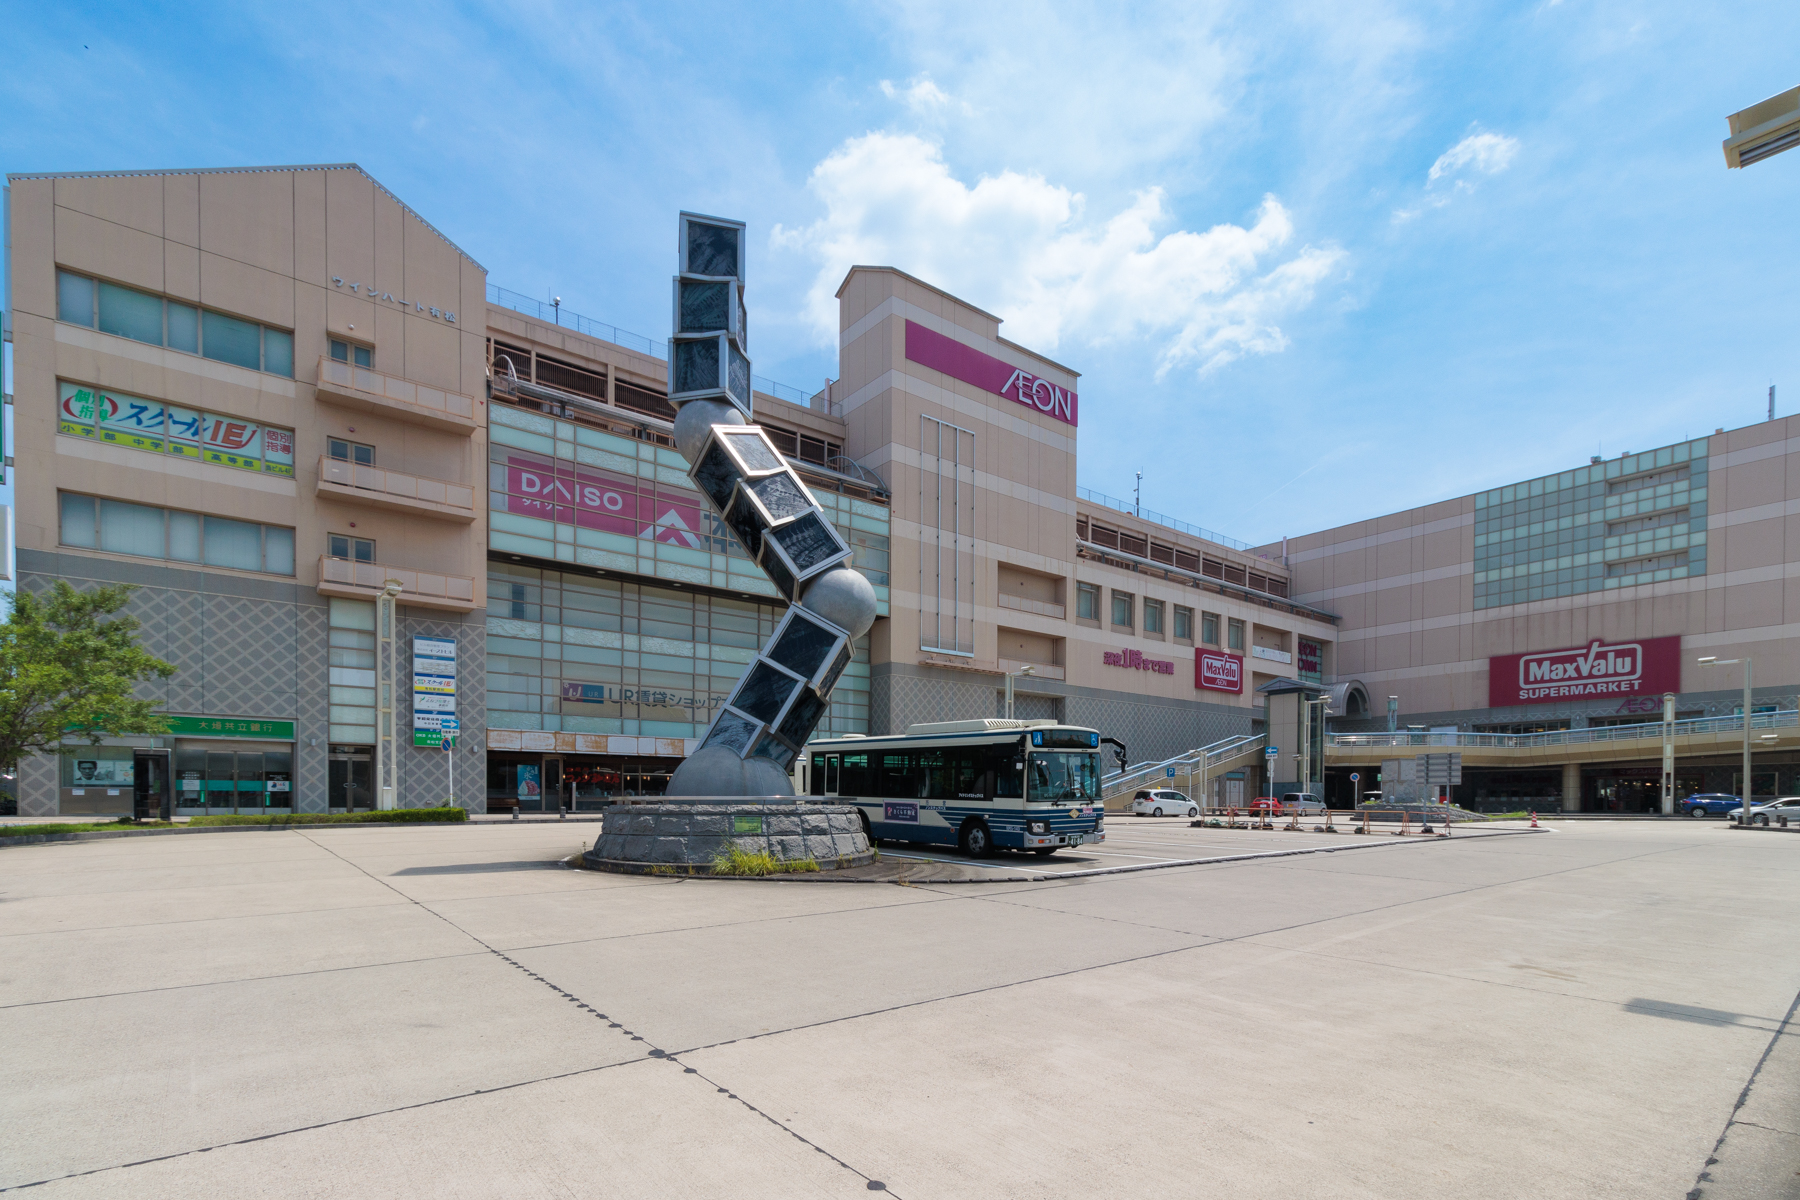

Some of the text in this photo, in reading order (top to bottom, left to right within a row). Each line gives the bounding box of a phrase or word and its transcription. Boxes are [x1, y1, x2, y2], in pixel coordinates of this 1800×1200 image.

[332, 275, 456, 323] ウインハート有松
[62, 424, 254, 468] 小学部 中学部 高等部
[266, 429, 292, 444] 個別
[266, 441, 292, 456] 指導
[521, 472, 623, 511] DAISO
[522, 498, 564, 511] ダイソー
[1103, 647, 1175, 676] 深夜1時まで営業
[1205, 654, 1237, 679] MaxValu
[1529, 641, 1632, 682] MaxValu
[1519, 680, 1643, 700] SUPERMARKET
[198, 721, 274, 732] 大垣共立銀行
[1168, 767, 1175, 777] P
